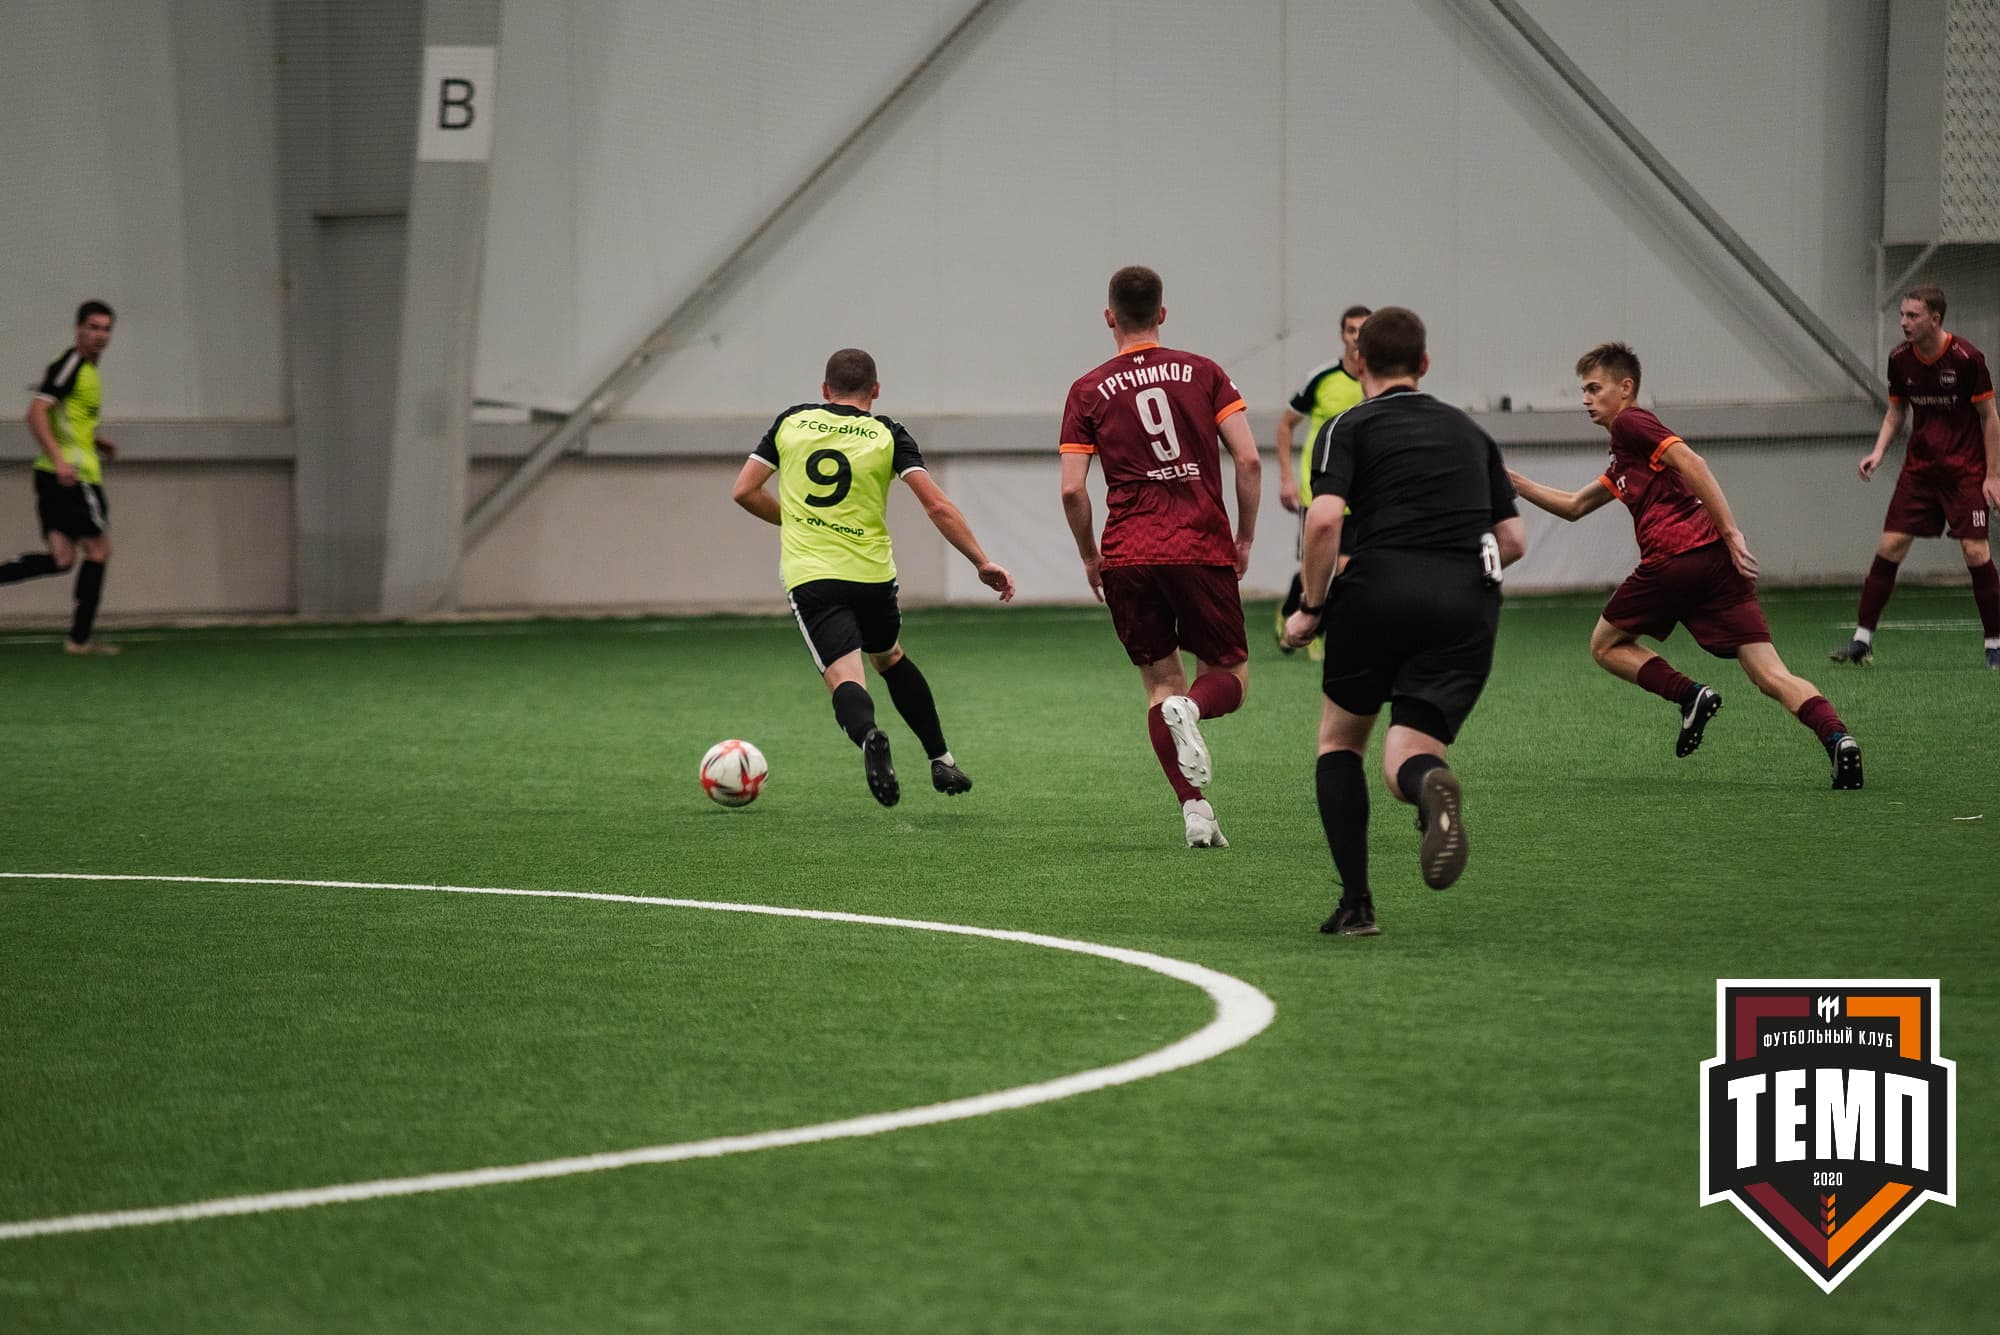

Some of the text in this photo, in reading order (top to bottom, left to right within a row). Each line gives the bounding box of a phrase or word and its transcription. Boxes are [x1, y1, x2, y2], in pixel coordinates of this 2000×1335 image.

[1097, 363, 1193, 400] ГРЕЧНИКОВ
[1135, 387, 1181, 462] 9
[804, 449, 853, 508] 9
[1147, 463, 1200, 480] SEUS
